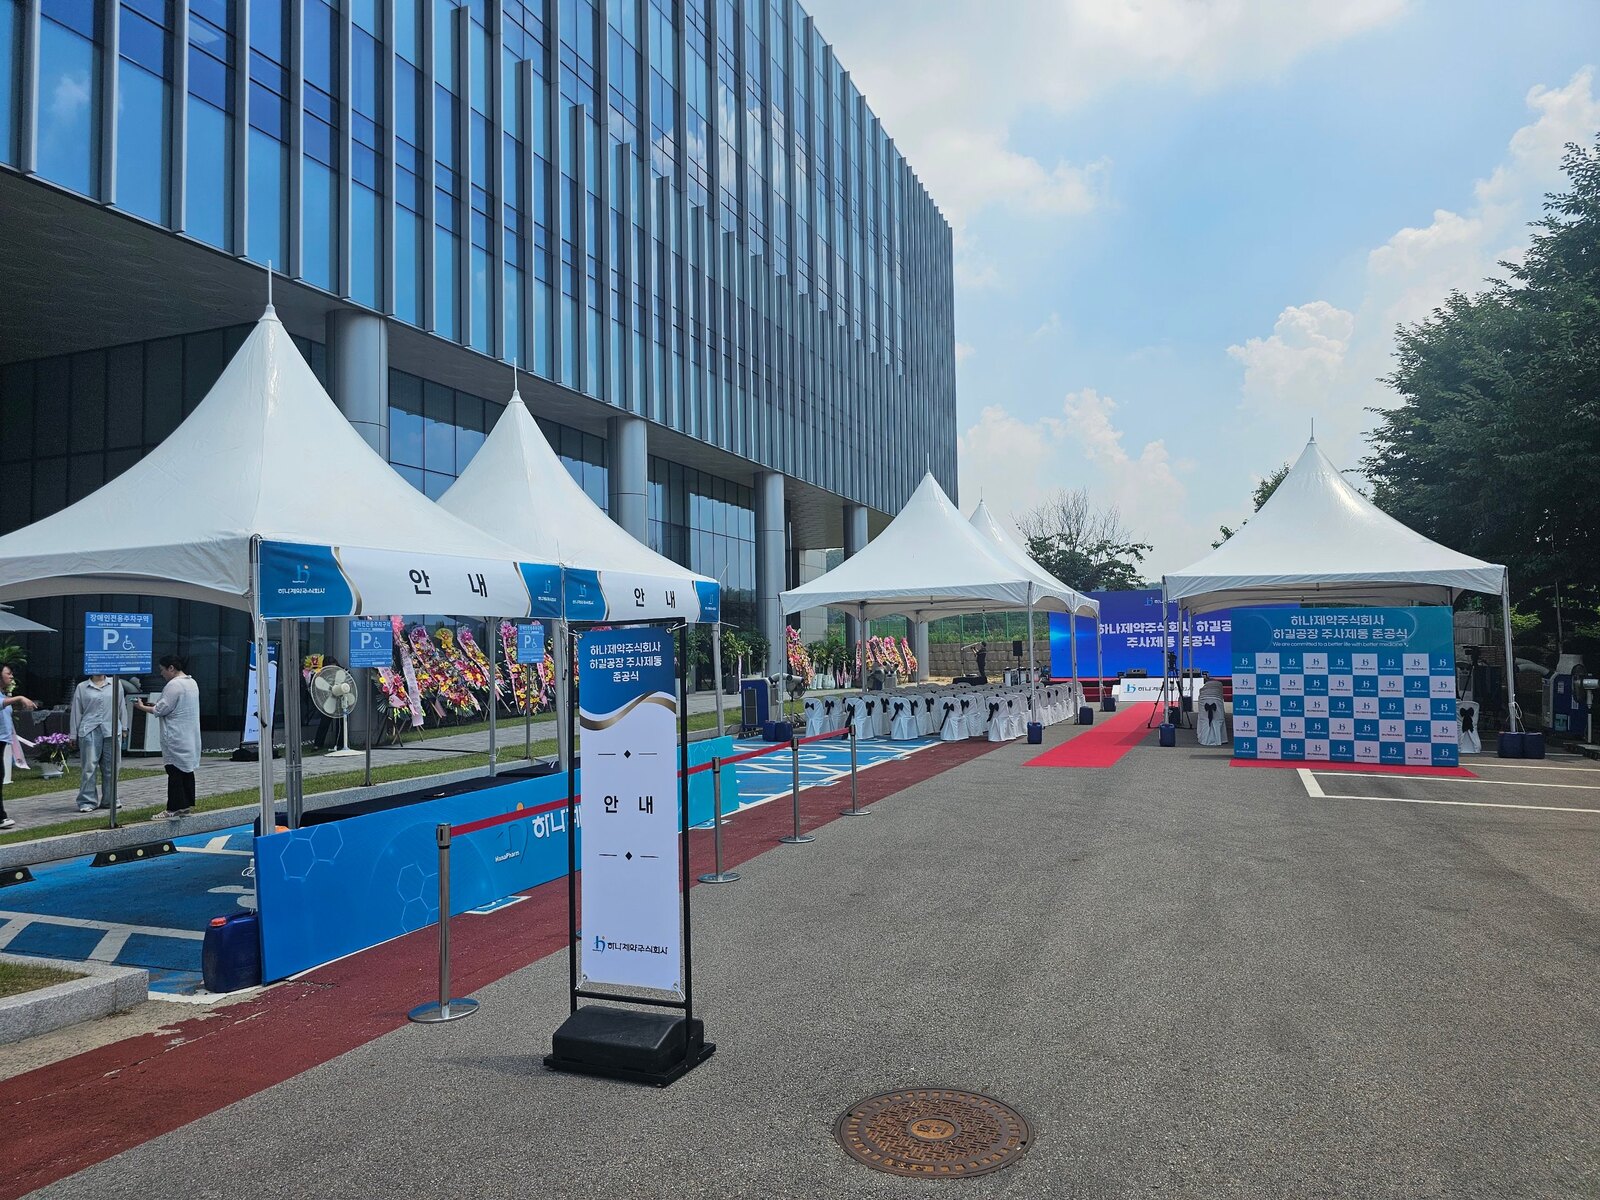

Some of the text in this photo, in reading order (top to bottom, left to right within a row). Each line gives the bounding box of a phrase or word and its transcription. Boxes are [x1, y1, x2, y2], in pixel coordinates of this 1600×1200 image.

[408, 569, 488, 598] 안 내
[633, 587, 676, 609] 안 내
[90, 614, 149, 623] 장애인전용주차구역
[1290, 614, 1385, 626] 하나제약주식회사
[103, 629, 120, 651] P
[361, 632, 372, 649] P
[1273, 627, 1408, 640] 하길공장 주사제동 준공식
[524, 635, 532, 649] P
[590, 642, 661, 656] 하나제약주식회사
[589, 656, 662, 669] 하길공장 주사제동
[613, 671, 639, 682] 준공식
[604, 795, 653, 814] 안 내
[607, 942, 668, 955] 하나제약주식회사
